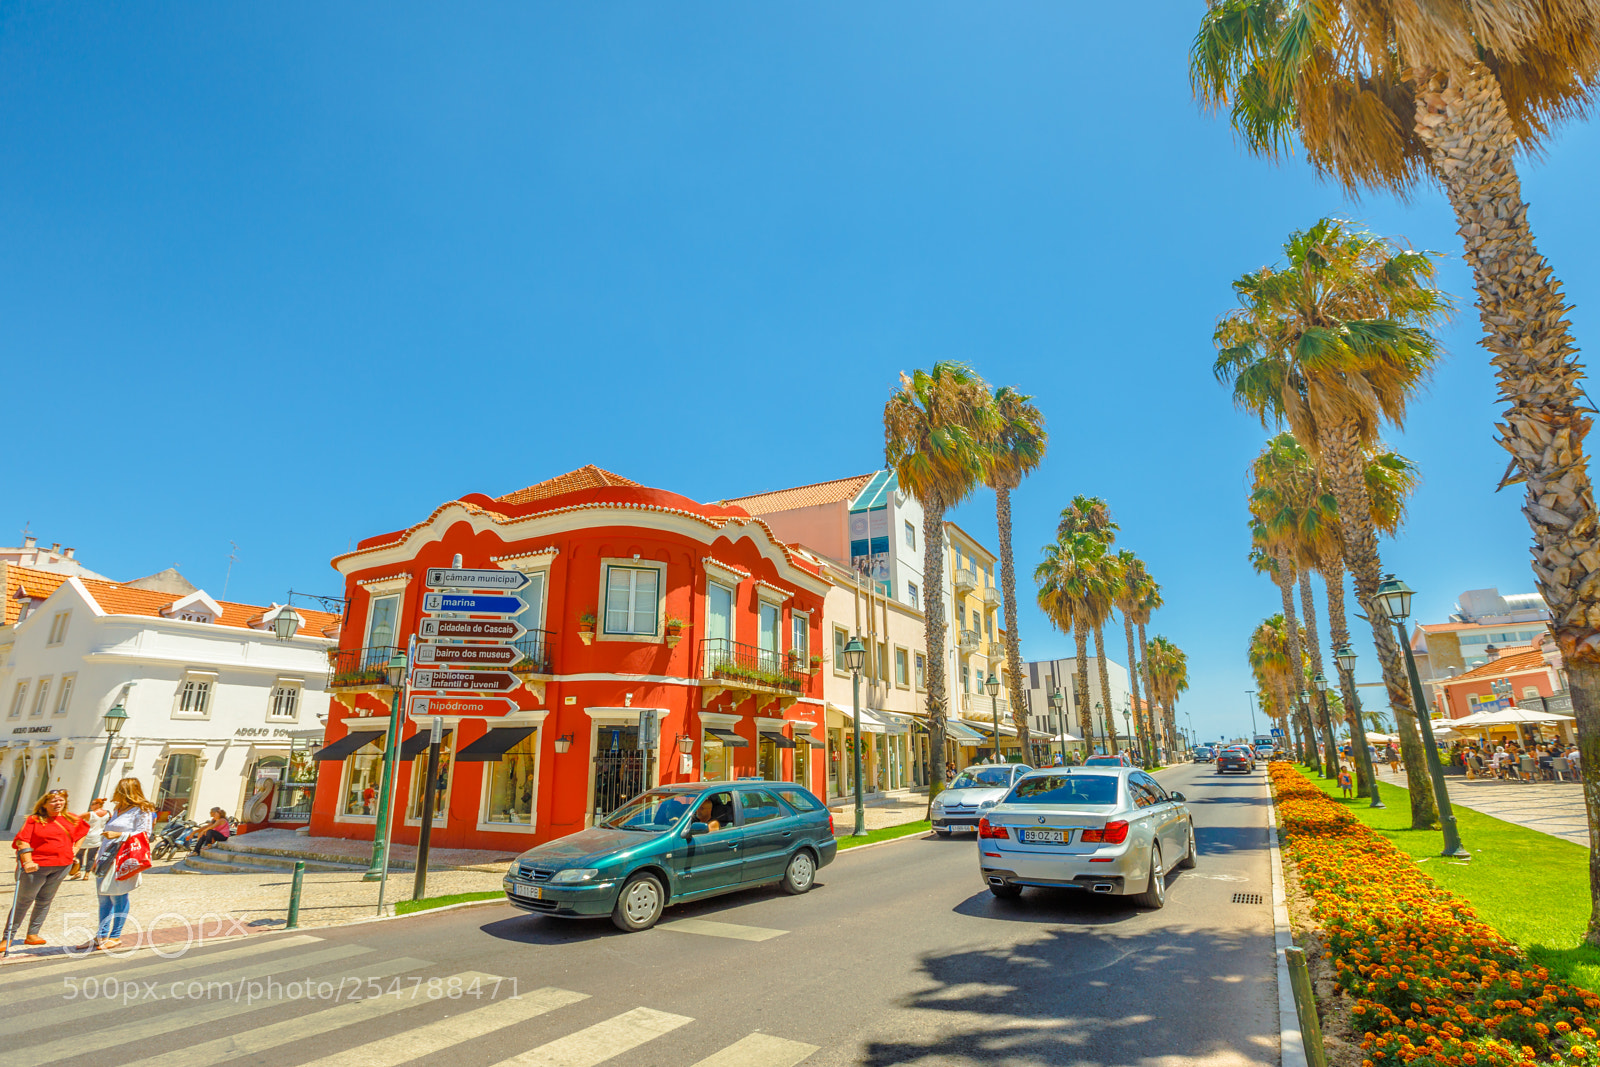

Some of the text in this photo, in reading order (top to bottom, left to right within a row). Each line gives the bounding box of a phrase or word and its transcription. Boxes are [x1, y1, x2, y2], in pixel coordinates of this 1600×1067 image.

[443, 598, 476, 607] marina
[440, 624, 514, 634] cidadela de Cascais
[436, 649, 511, 659] bairro dos museus
[430, 701, 484, 712] hipódromo
[234, 728, 269, 736] ADOLFO
